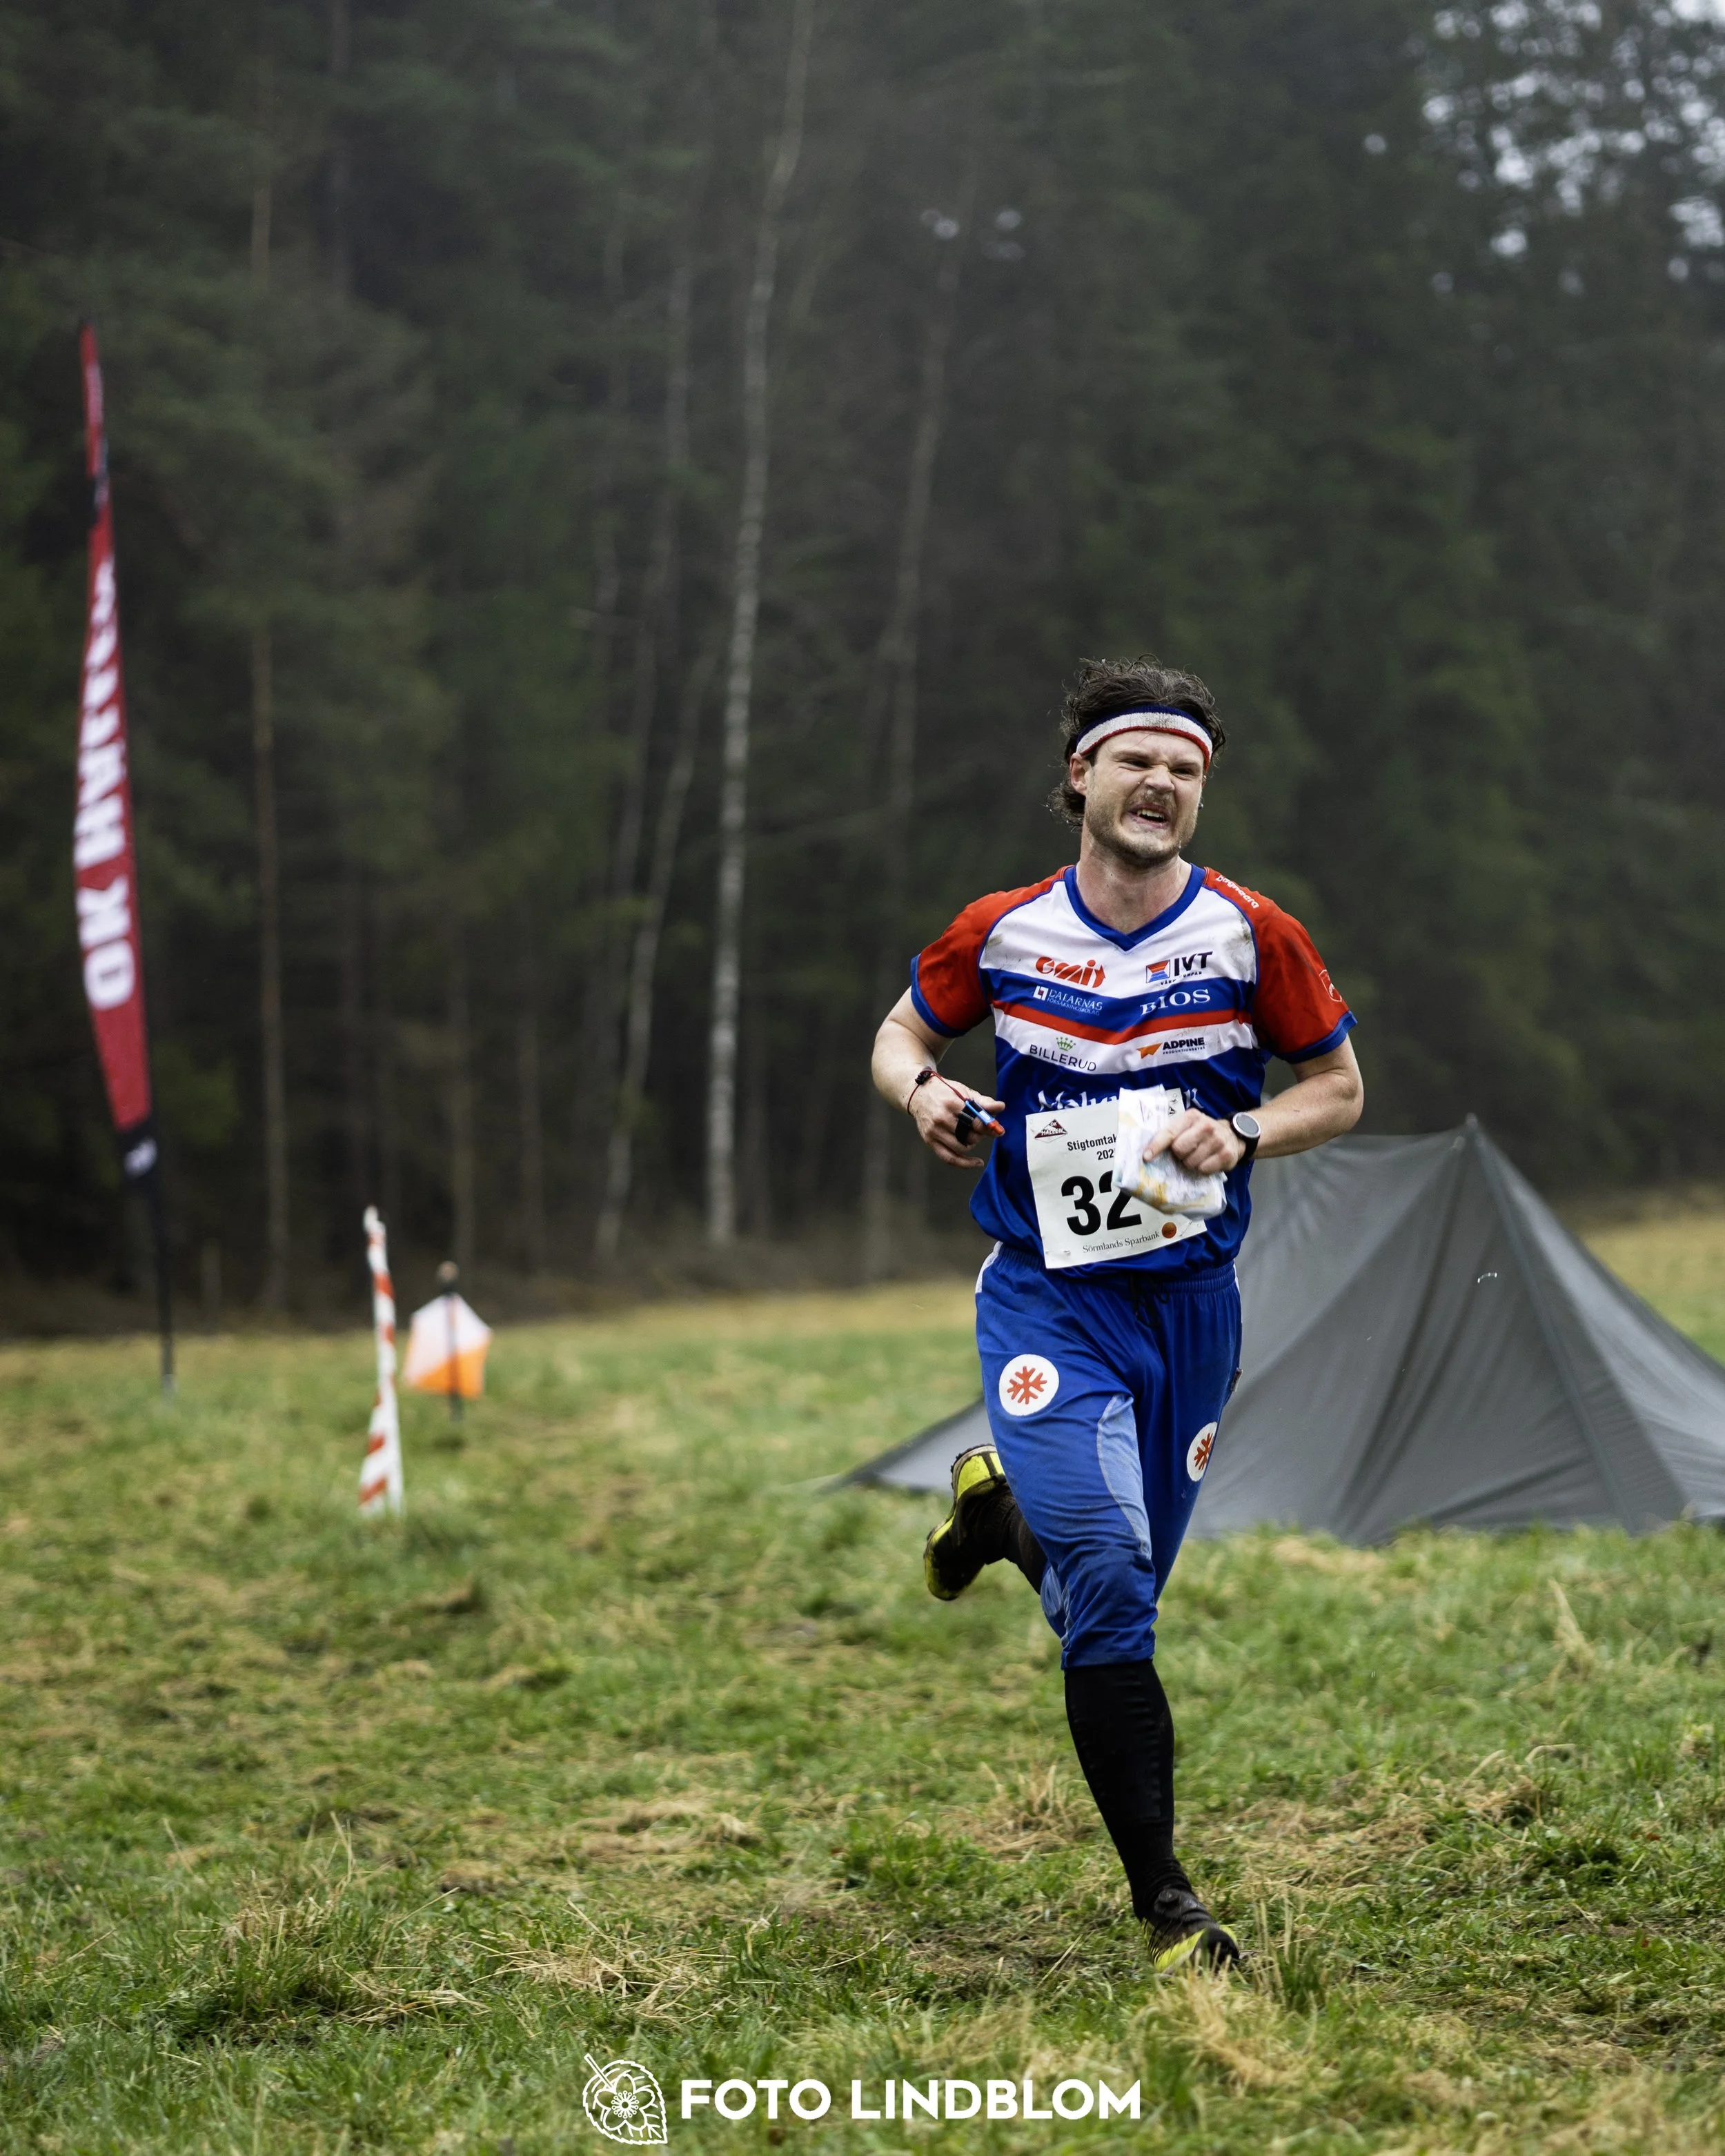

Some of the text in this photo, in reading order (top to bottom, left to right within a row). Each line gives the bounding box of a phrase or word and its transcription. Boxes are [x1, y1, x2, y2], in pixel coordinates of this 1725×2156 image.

[1174, 951, 1213, 976] IVT
[1140, 989, 1210, 1016] BIOS
[1163, 1037, 1205, 1050] ADPINE
[1029, 1044, 1096, 1071] BILLERUD
[1096, 1148, 1116, 1160] 202
[1061, 1170, 1142, 1236] 32
[1083, 1231, 1161, 1254] Sörmlands Sparbank
